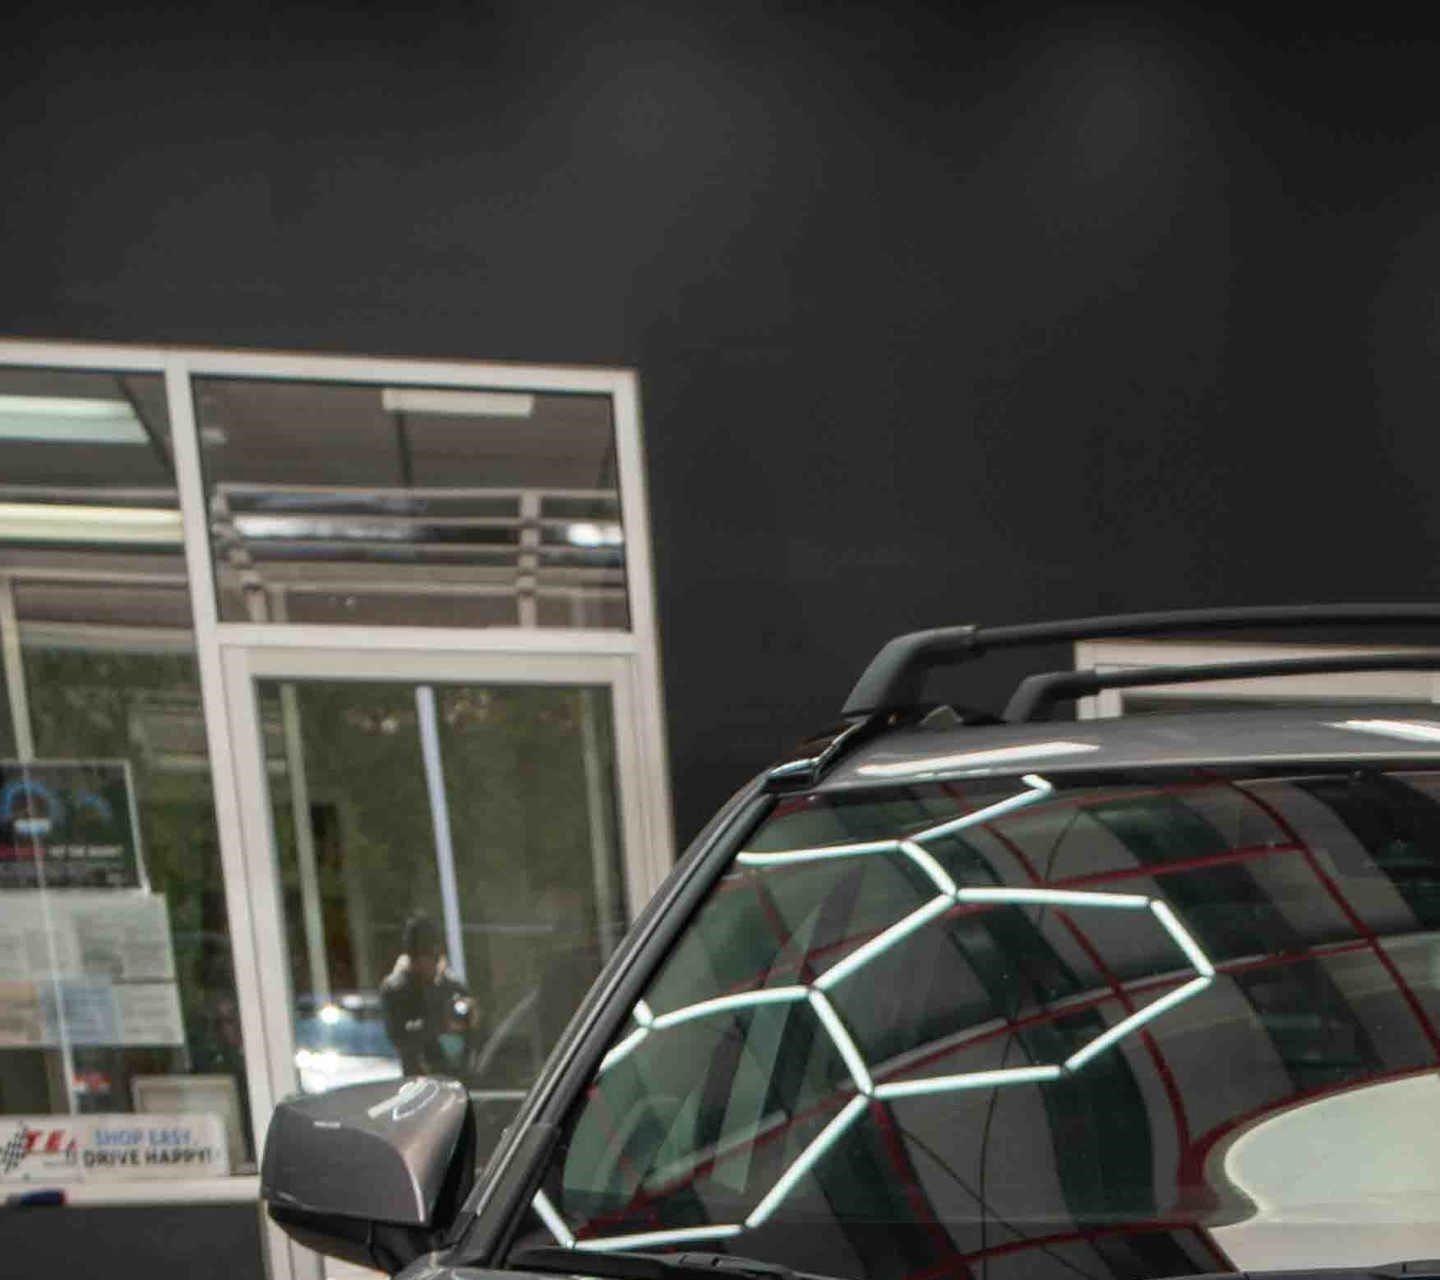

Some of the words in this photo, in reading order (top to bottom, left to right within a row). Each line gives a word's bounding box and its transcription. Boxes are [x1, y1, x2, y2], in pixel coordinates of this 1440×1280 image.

[94, 1129, 143, 1146] SHOP
[83, 1148, 140, 1168] DRIVE
[145, 1145, 212, 1165] HAPPY!
